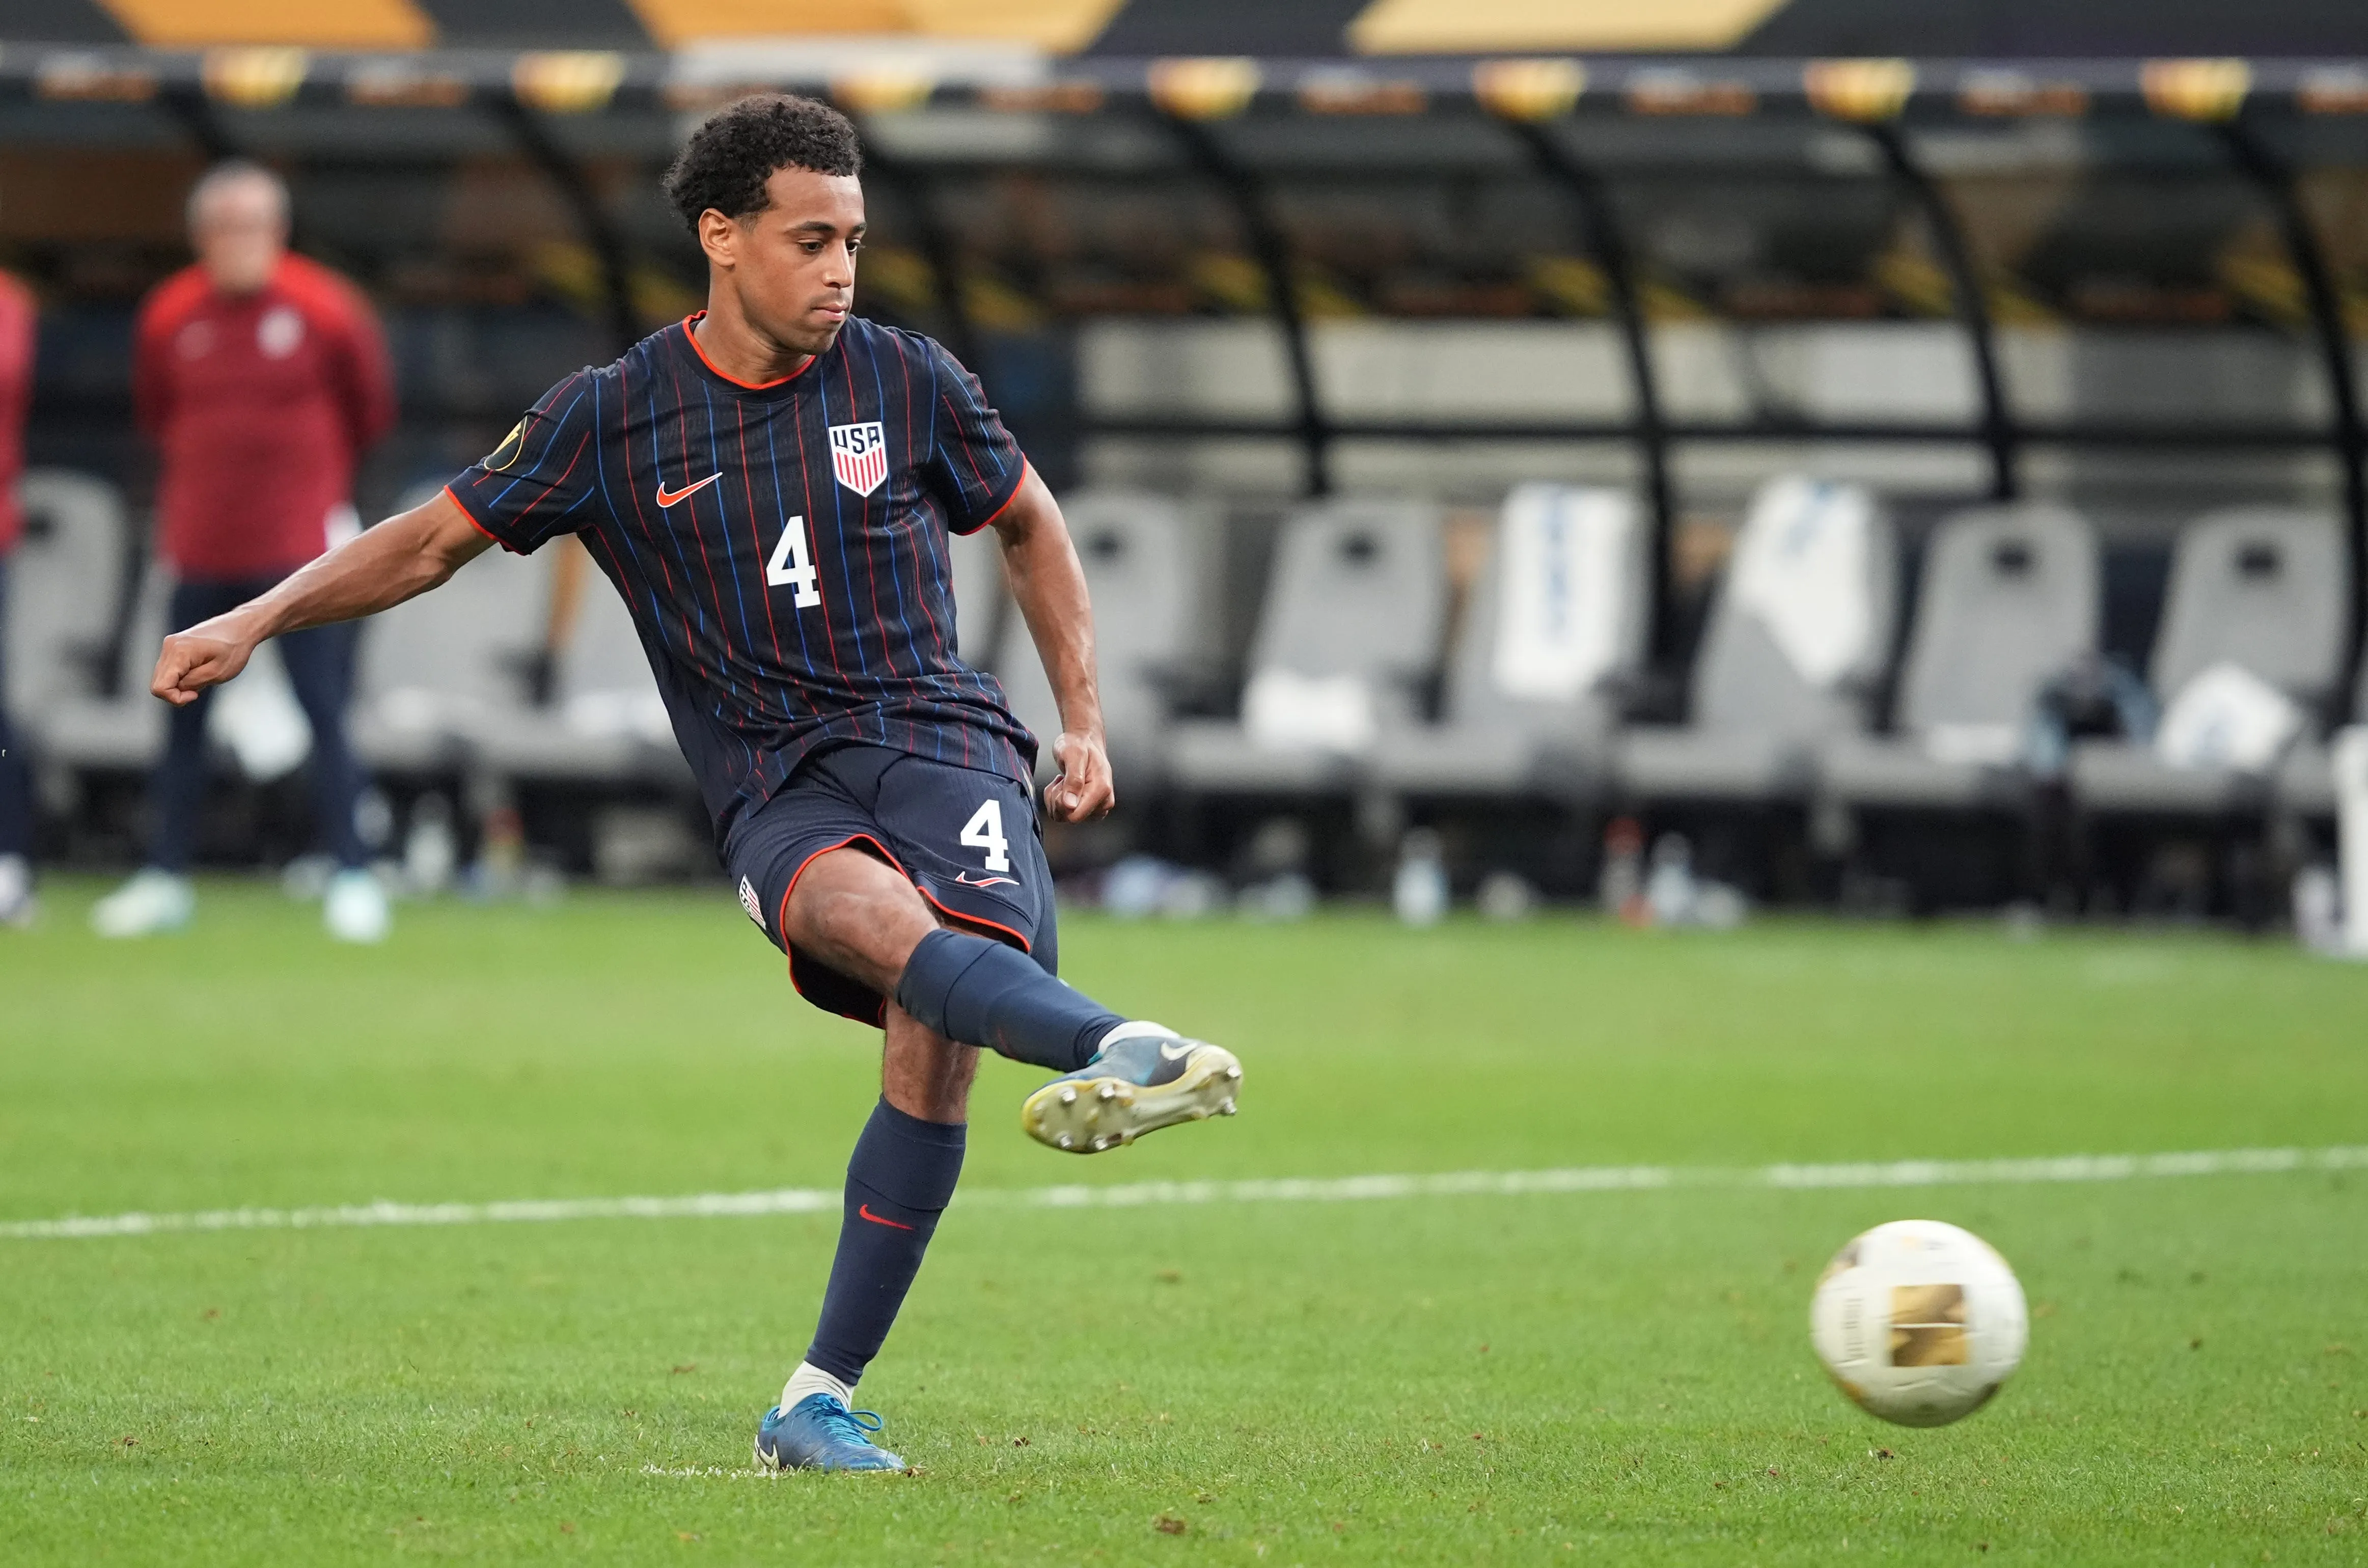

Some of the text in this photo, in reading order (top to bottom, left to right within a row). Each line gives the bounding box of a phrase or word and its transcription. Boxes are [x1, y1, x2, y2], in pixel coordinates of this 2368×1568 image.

[833, 426, 880, 454] USA
[766, 515, 820, 608] 4
[960, 799, 1009, 872] 4
